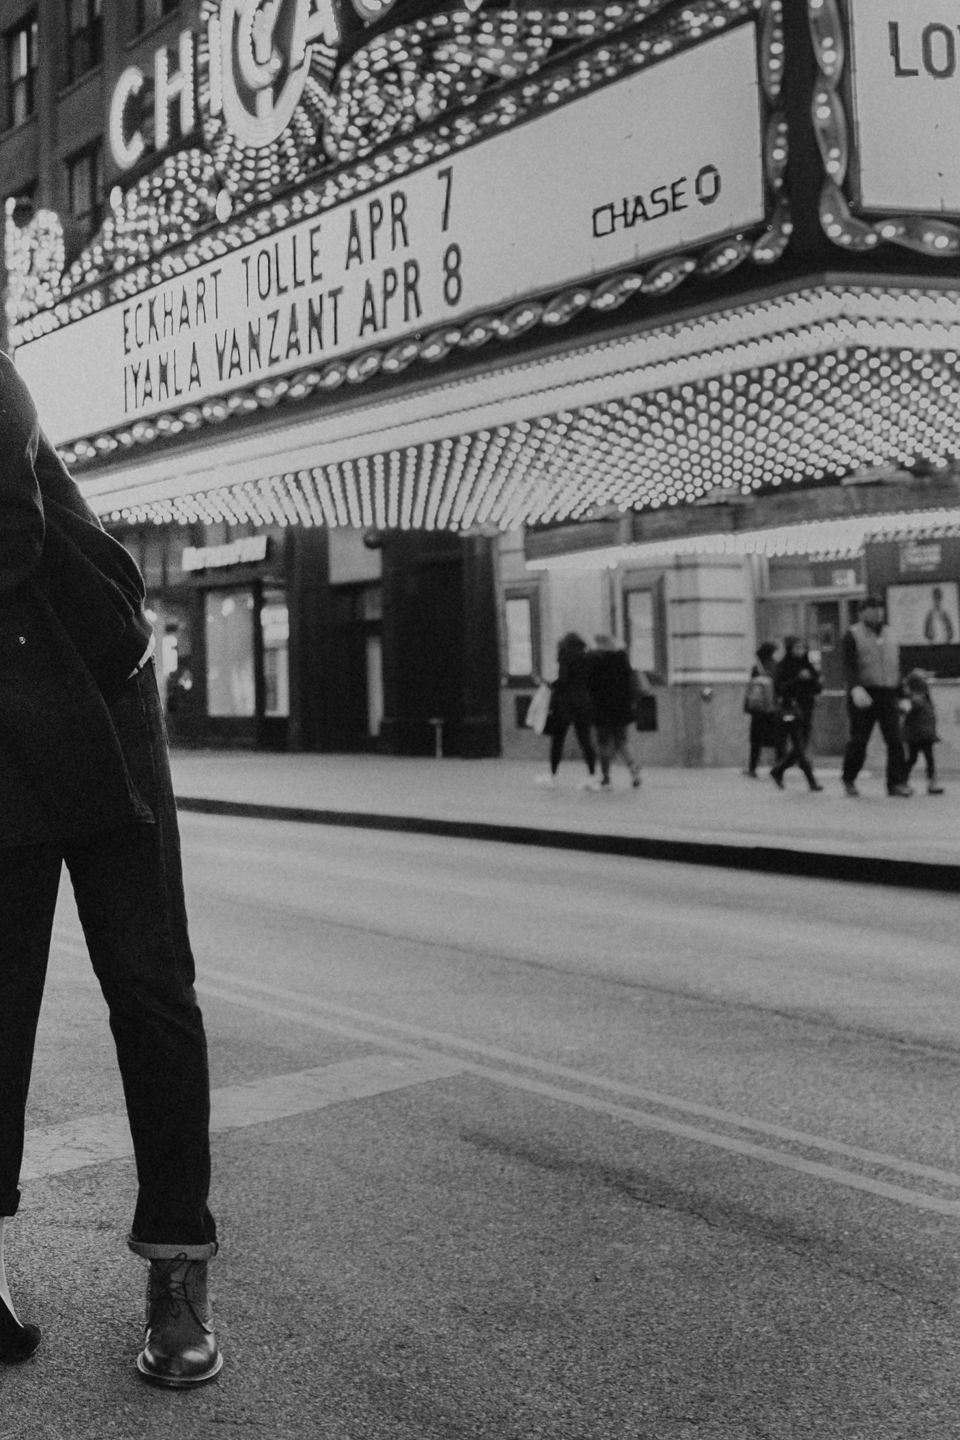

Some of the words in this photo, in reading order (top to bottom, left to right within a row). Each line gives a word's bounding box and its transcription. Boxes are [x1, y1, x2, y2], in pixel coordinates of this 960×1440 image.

[888, 21, 960, 81] LO
[123, 268, 222, 356] ECKHART
[241, 224, 323, 307] TOLLE
[345, 190, 410, 271] APR
[437, 165, 454, 233] 7
[592, 174, 689, 238] CHASE
[123, 341, 202, 413] IYANLA
[214, 286, 344, 382] VANZANT
[358, 258, 423, 338] APR
[442, 242, 463, 307] 8
